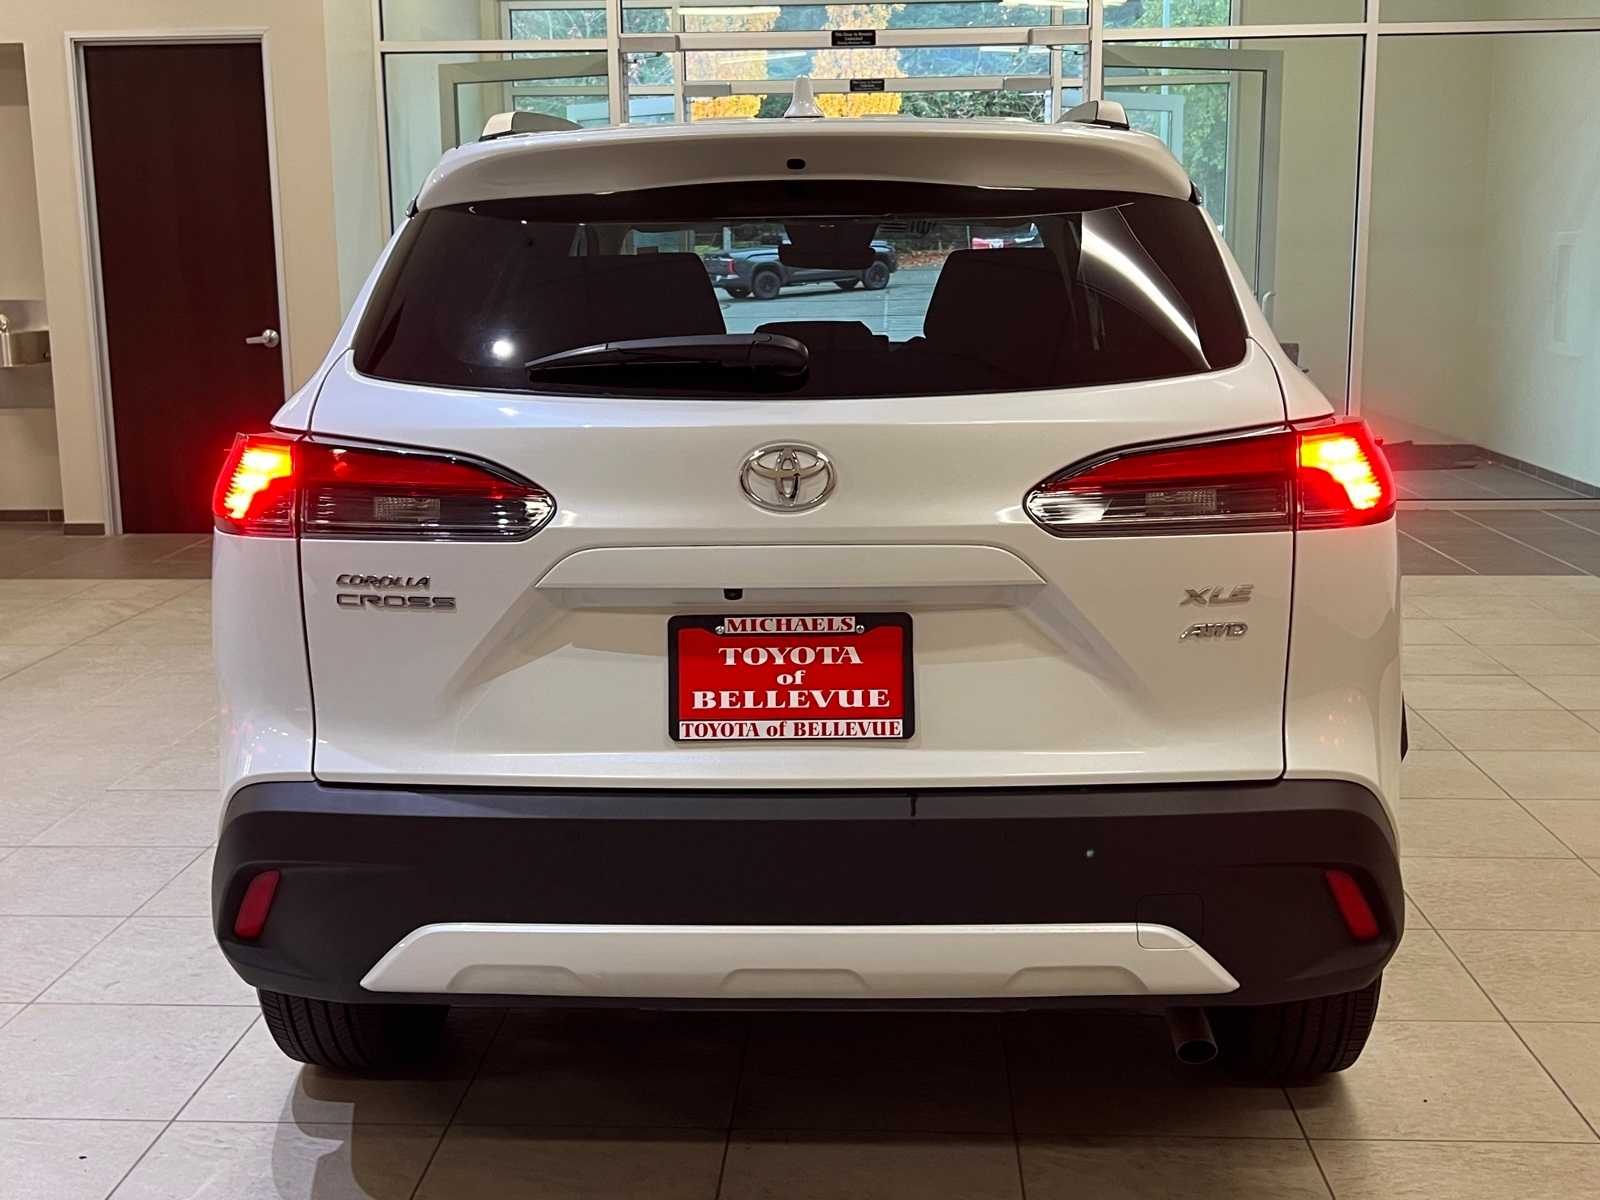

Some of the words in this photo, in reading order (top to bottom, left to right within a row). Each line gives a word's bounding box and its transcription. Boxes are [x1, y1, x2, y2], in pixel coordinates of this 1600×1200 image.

[336, 574, 431, 589] COROLLA
[336, 593, 457, 609] CROSS
[1179, 583, 1255, 607] XLE
[727, 616, 854, 633] MICHAELS
[1180, 622, 1249, 640] AWD
[718, 646, 863, 666] TOYOTA
[776, 669, 806, 685] of
[692, 689, 890, 710] BELLEVUE
[681, 722, 759, 738] TOYOTA
[766, 721, 787, 737] of
[793, 720, 901, 737] BELLEVUE
